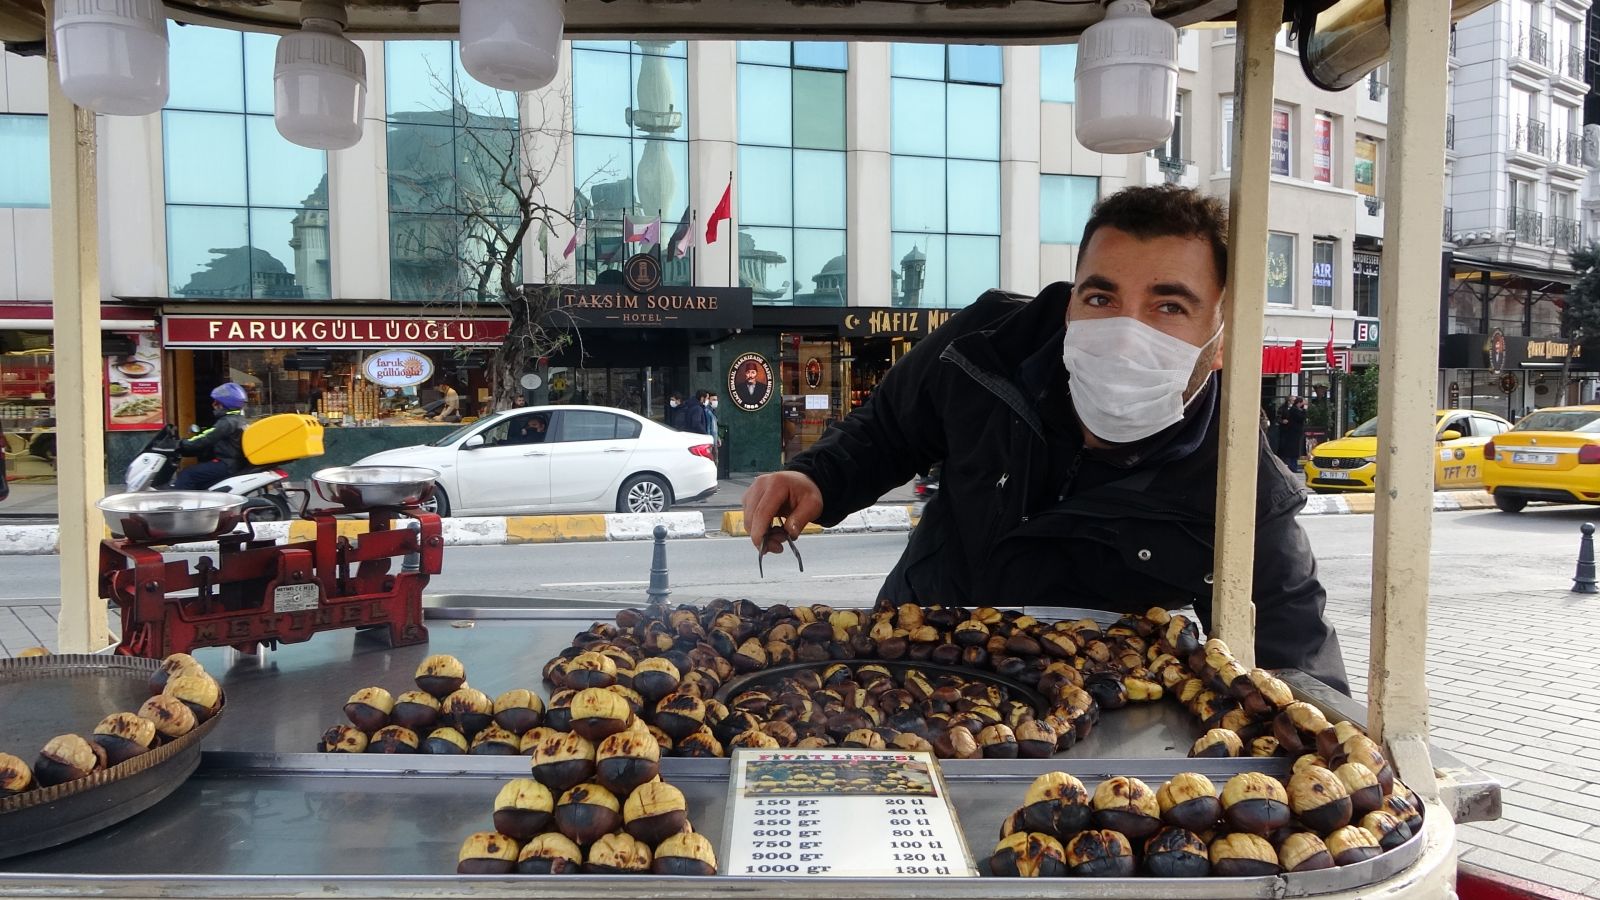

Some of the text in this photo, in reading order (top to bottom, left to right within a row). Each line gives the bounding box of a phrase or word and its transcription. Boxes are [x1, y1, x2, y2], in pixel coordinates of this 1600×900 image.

[1312, 263, 1331, 278] AIR
[564, 292, 718, 310] TAKSİM SQUARE
[623, 313, 662, 322] HOTEL
[869, 310, 918, 334] HAFIZ
[377, 357, 403, 367] faruk
[1443, 465, 1477, 480] TFT 73
[759, 753, 825, 761] FİYAT
[799, 830, 821, 838] gr
[800, 853, 823, 861] gr
[745, 865, 799, 873] 1000
[807, 866, 831, 874] gr
[936, 866, 950, 875] tl
